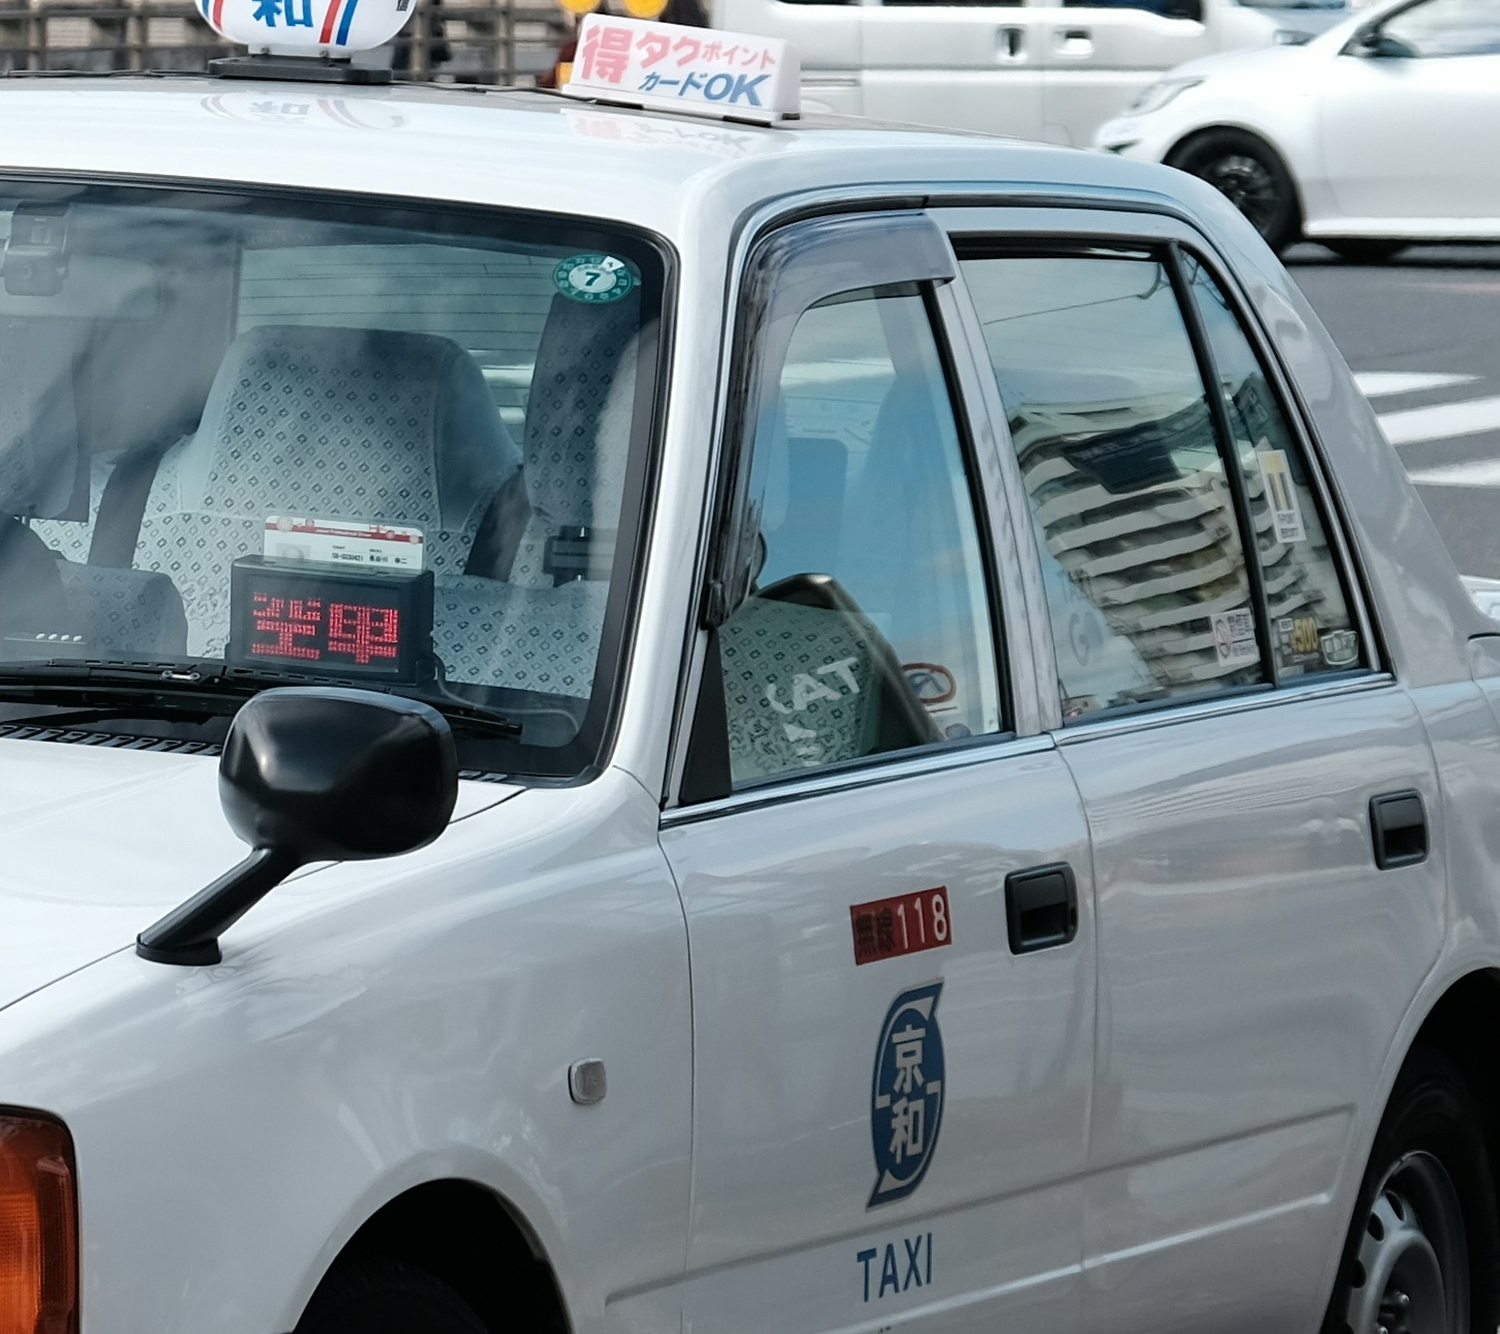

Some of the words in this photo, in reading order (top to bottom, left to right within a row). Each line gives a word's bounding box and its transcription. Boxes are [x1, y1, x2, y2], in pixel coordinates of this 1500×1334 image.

[580, 24, 635, 85] 得
[637, 70, 773, 107] カードOK
[585, 271, 601, 287] 7
[251, 591, 400, 664] 空車
[897, 893, 949, 950] 118
[888, 1024, 927, 1165] 京和
[855, 1232, 934, 1304] TAXI
